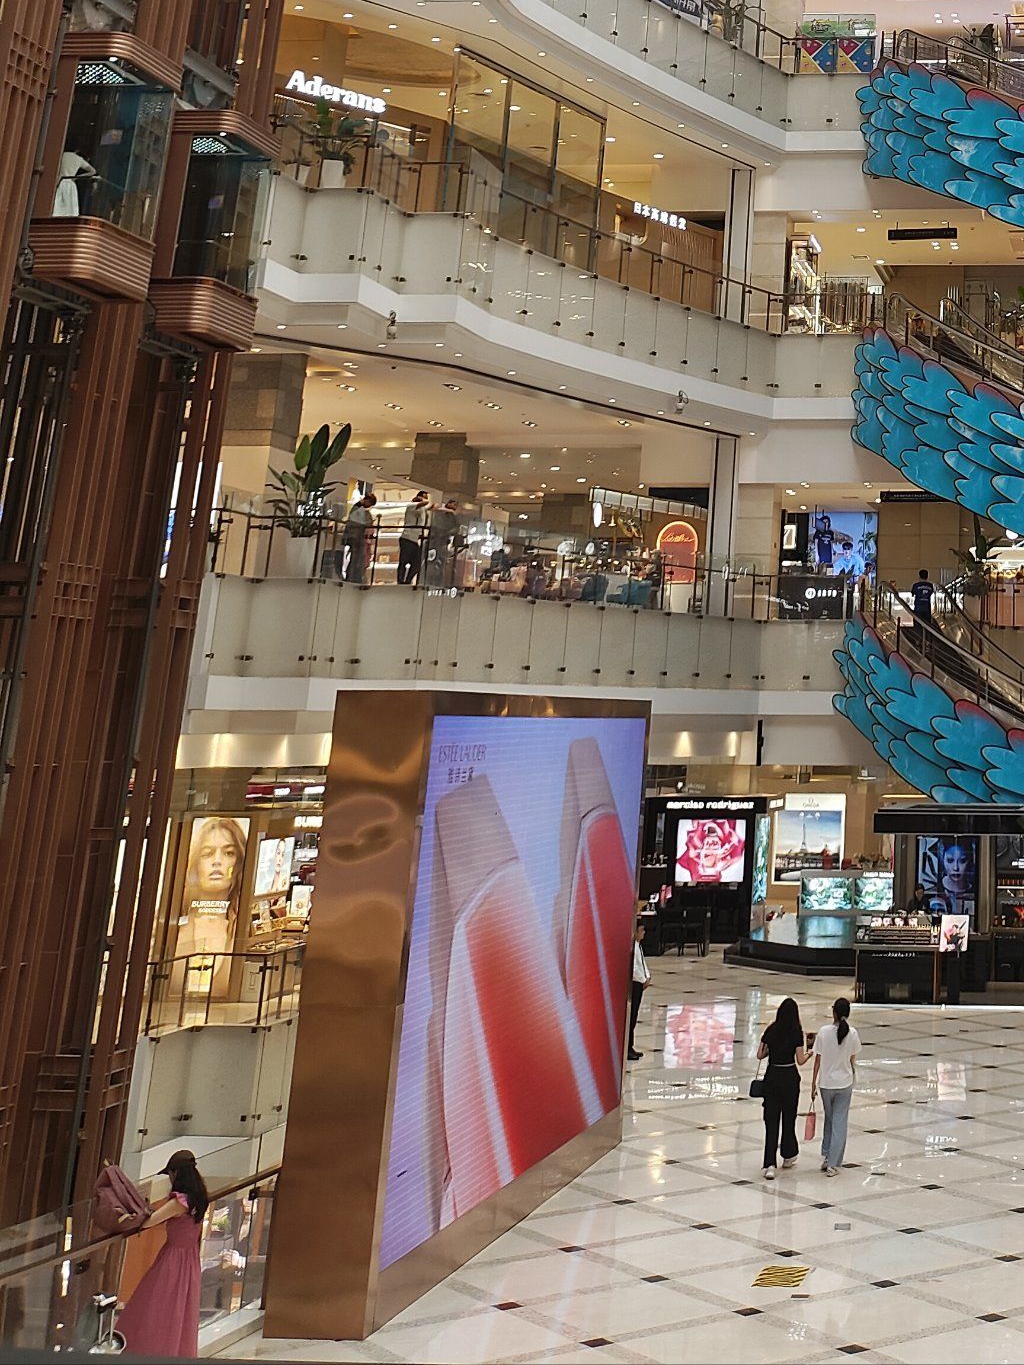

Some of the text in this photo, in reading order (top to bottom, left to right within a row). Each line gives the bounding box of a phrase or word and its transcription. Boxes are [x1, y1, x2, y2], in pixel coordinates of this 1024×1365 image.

[285, 70, 387, 114] Aderans
[666, 799, 754, 811] narciso rodriguez
[191, 900, 230, 908] BURBERRY
